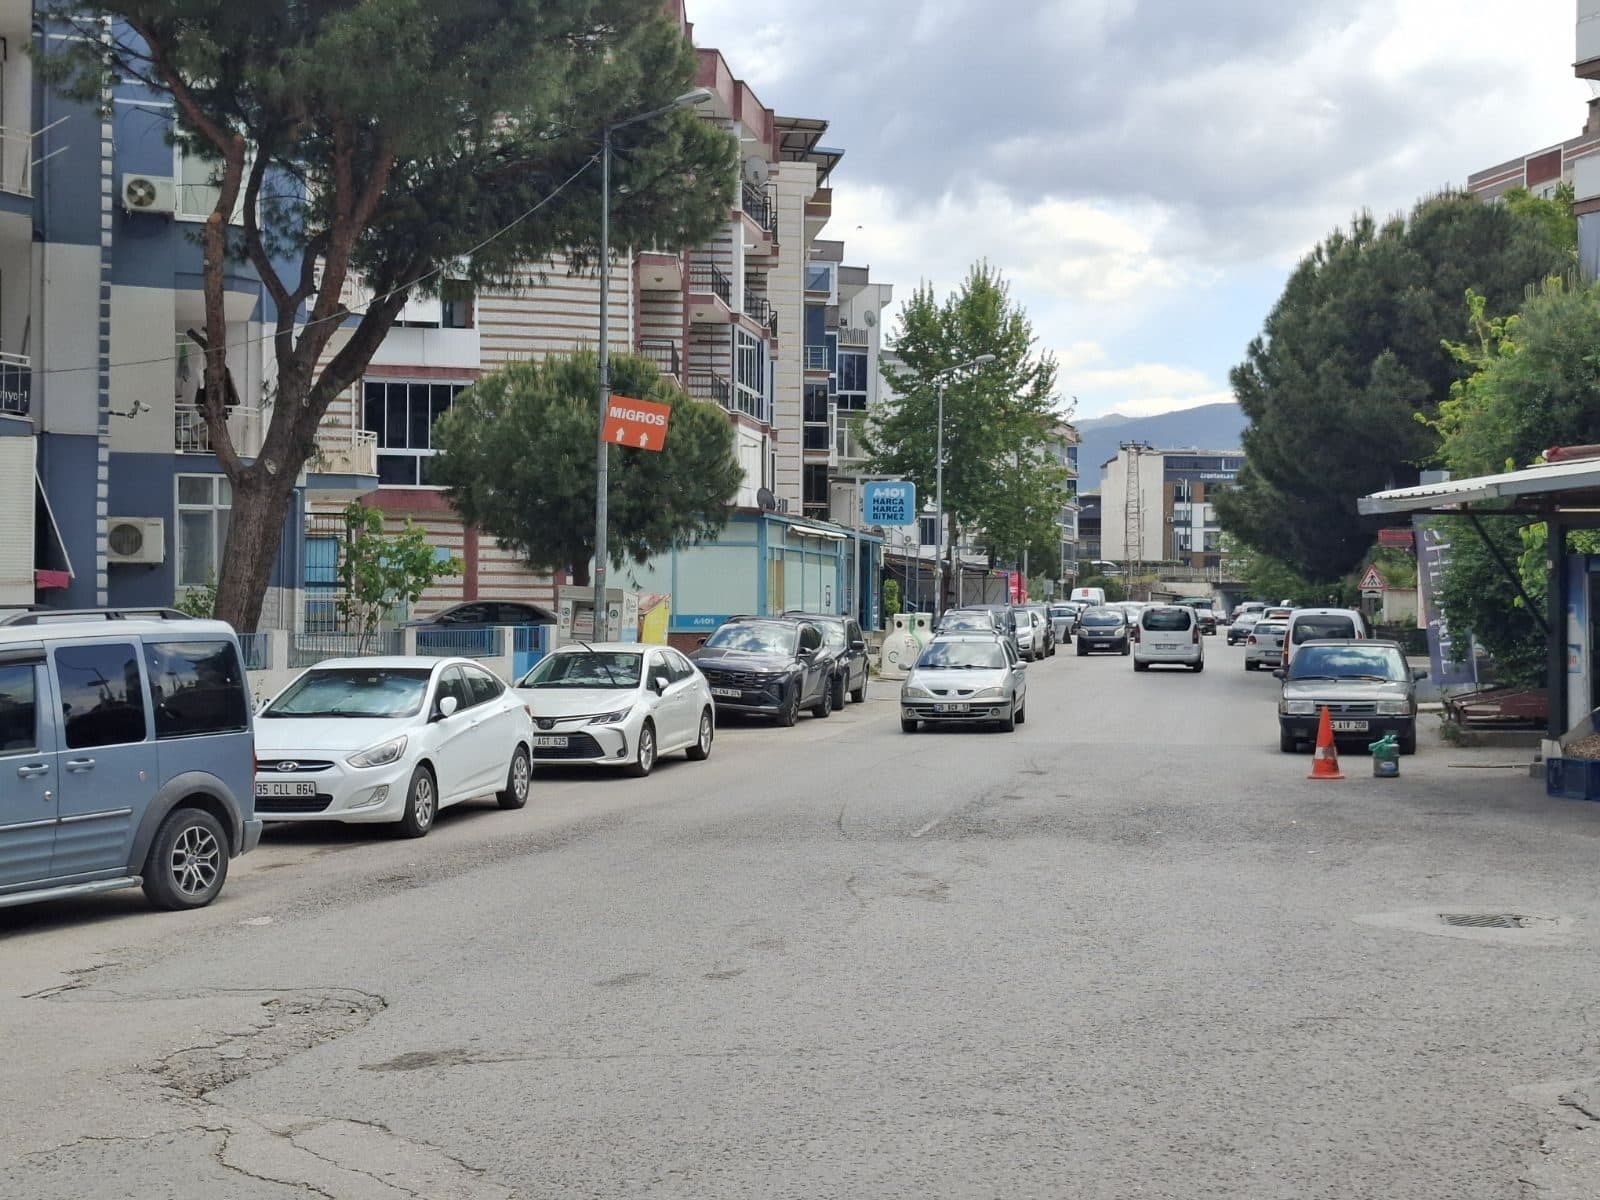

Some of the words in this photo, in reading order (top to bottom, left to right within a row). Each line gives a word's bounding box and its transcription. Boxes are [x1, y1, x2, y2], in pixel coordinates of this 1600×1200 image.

[256, 784, 268, 795] 35
[273, 783, 291, 795] CLL
[296, 783, 314, 795] 864
